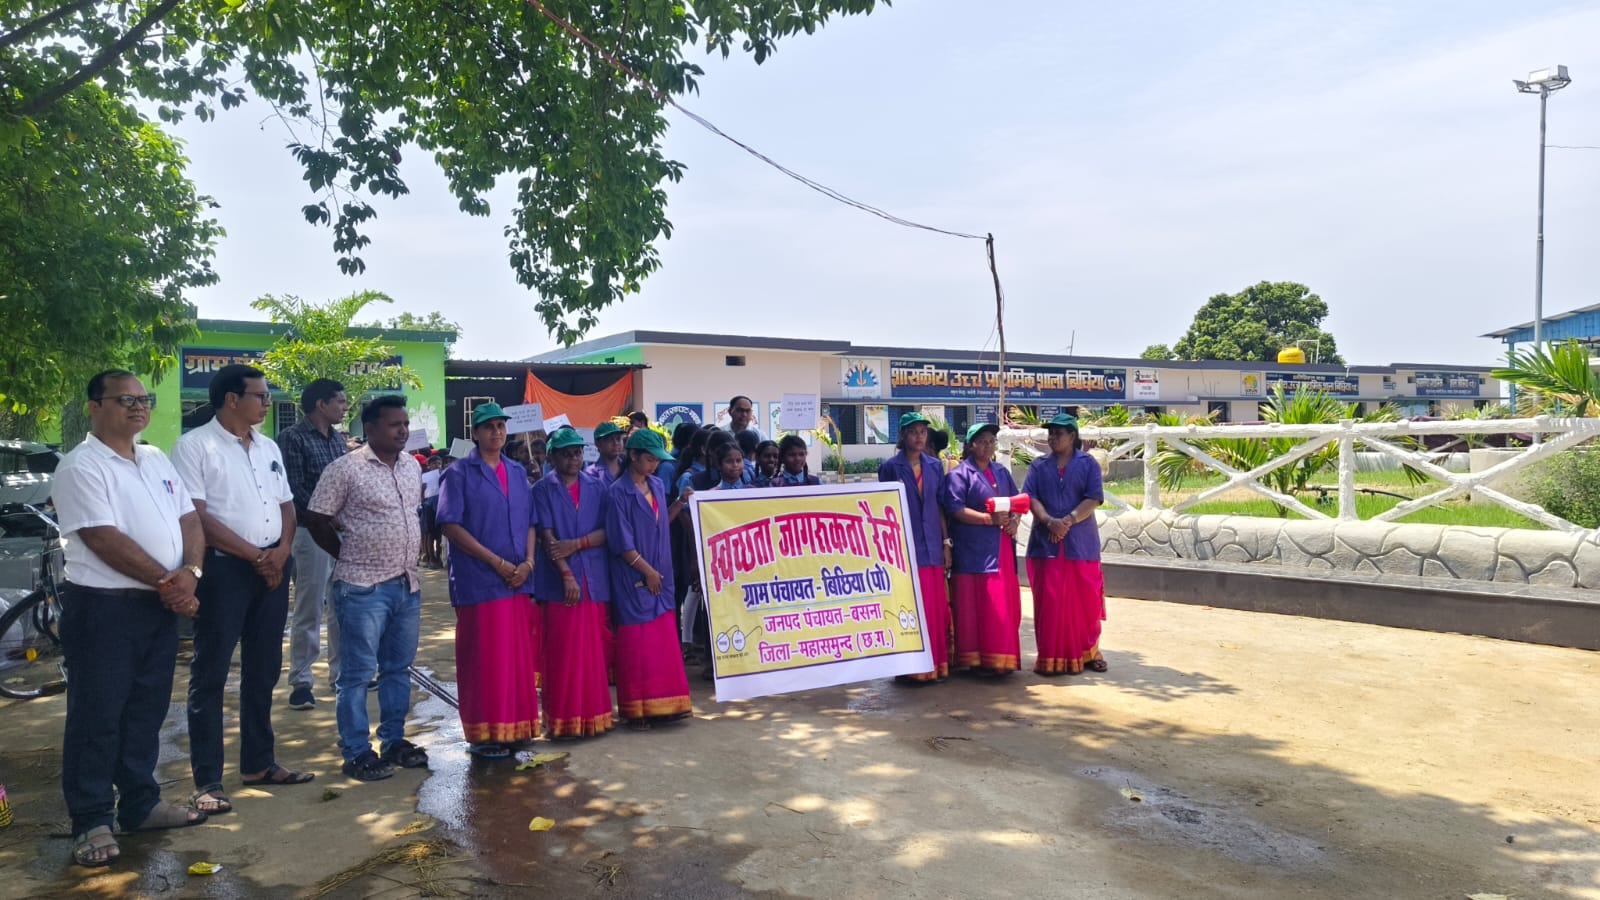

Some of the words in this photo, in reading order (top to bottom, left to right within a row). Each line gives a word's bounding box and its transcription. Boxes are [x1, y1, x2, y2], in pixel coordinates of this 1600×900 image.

[891, 364, 948, 388] शासकीय
[950, 370, 982, 387] उच्च
[1037, 373, 1064, 391] शाला
[707, 518, 775, 592] स्वच्छता
[858, 501, 906, 573] रैली
[742, 582, 770, 608] ग्राम
[764, 613, 801, 633] जनपद
